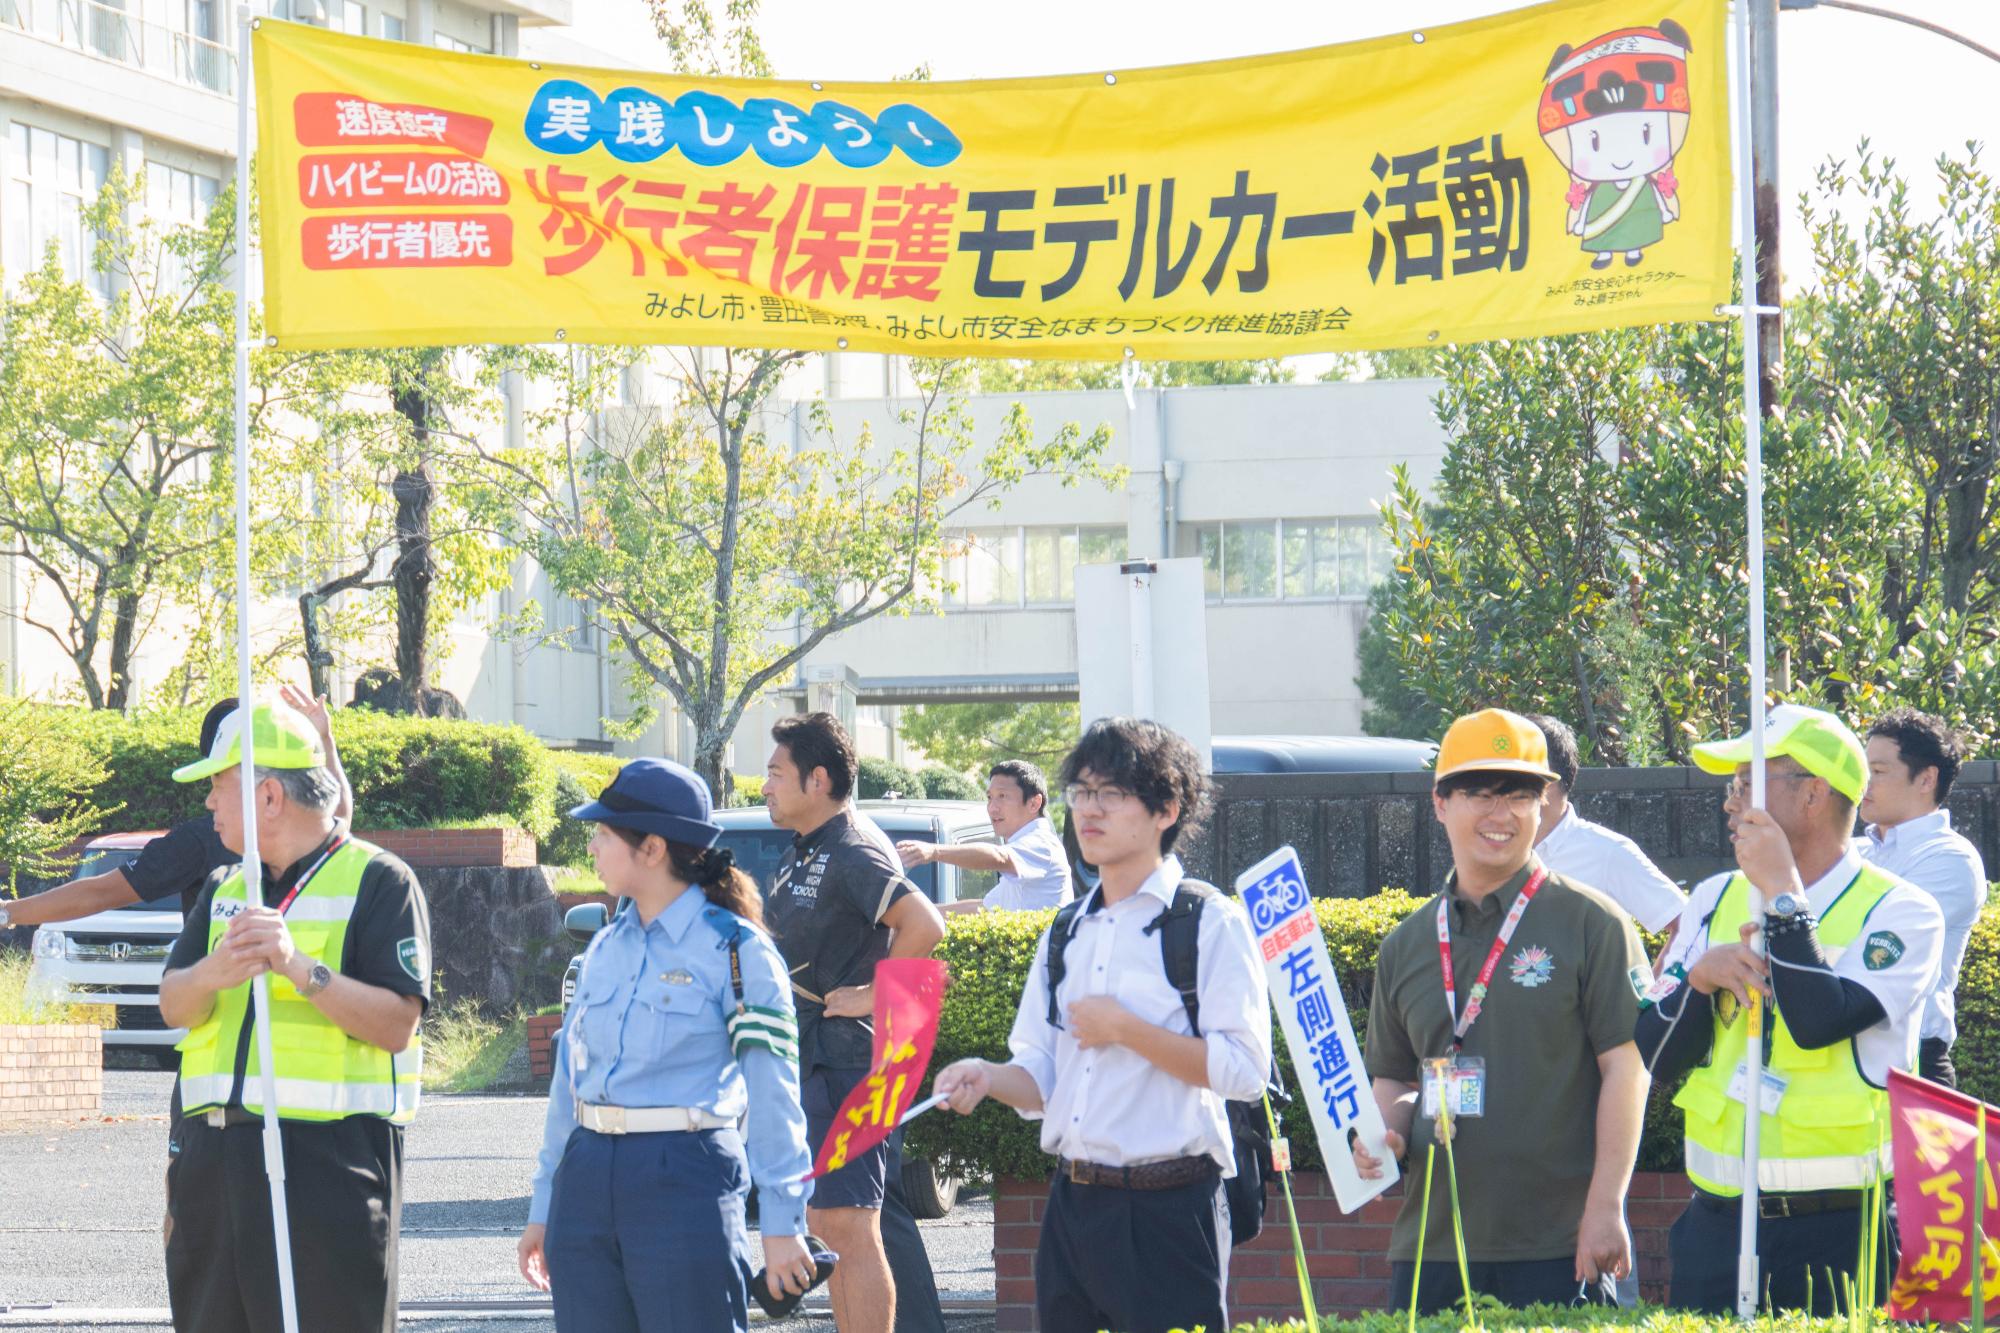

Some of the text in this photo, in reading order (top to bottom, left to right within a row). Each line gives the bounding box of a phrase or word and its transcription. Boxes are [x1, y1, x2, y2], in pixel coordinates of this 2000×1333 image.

[539, 95, 934, 148] 実践しよう！
[308, 160, 502, 198] ハイビームの活用
[326, 219, 492, 262] 歩行者優先
[523, 132, 1531, 304] 歩行者保護モデルカー活動
[792, 884, 818, 898] SCHOOL
[1261, 911, 1316, 962] 自転車は
[1280, 945, 1360, 1130] 左側通行
